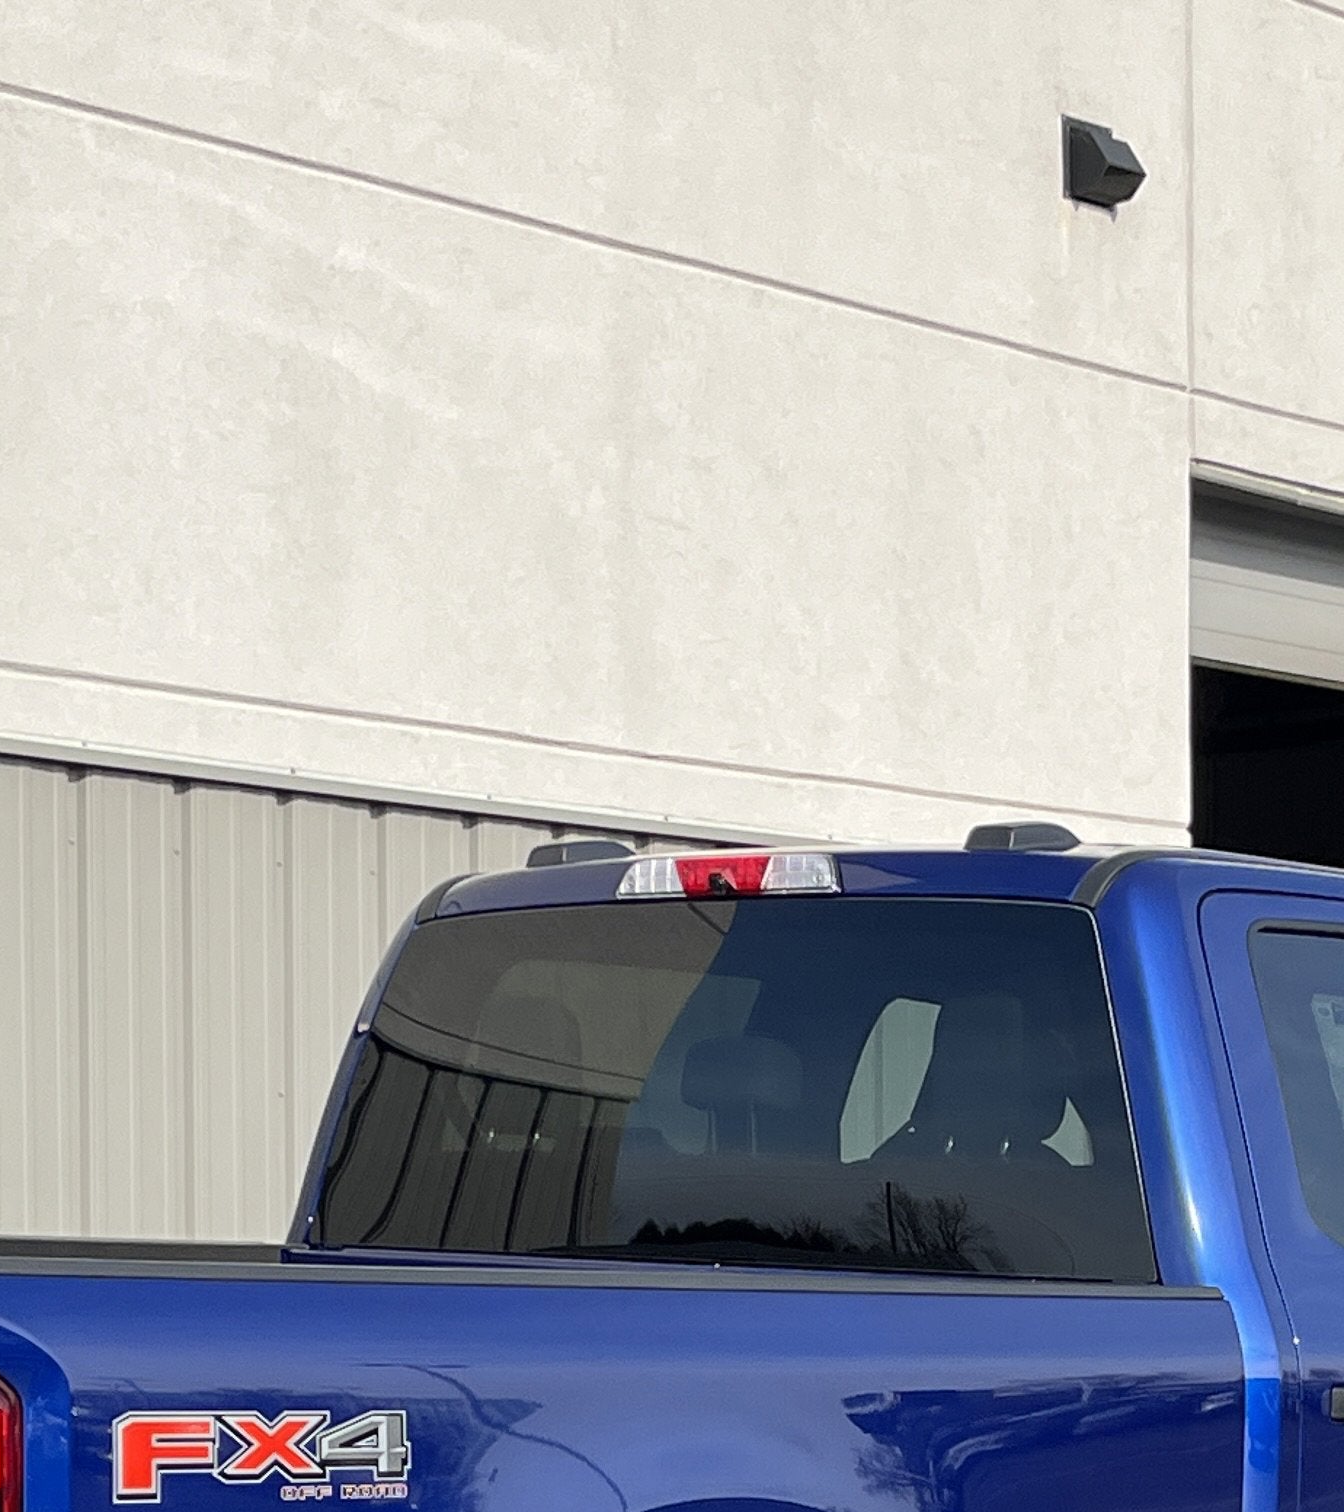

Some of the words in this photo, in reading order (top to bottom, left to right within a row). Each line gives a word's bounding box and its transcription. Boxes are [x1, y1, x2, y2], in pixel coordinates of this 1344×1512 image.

[113, 1411, 411, 1503] FX4
[280, 1484, 333, 1501] OFF
[340, 1483, 408, 1499] ROAD
